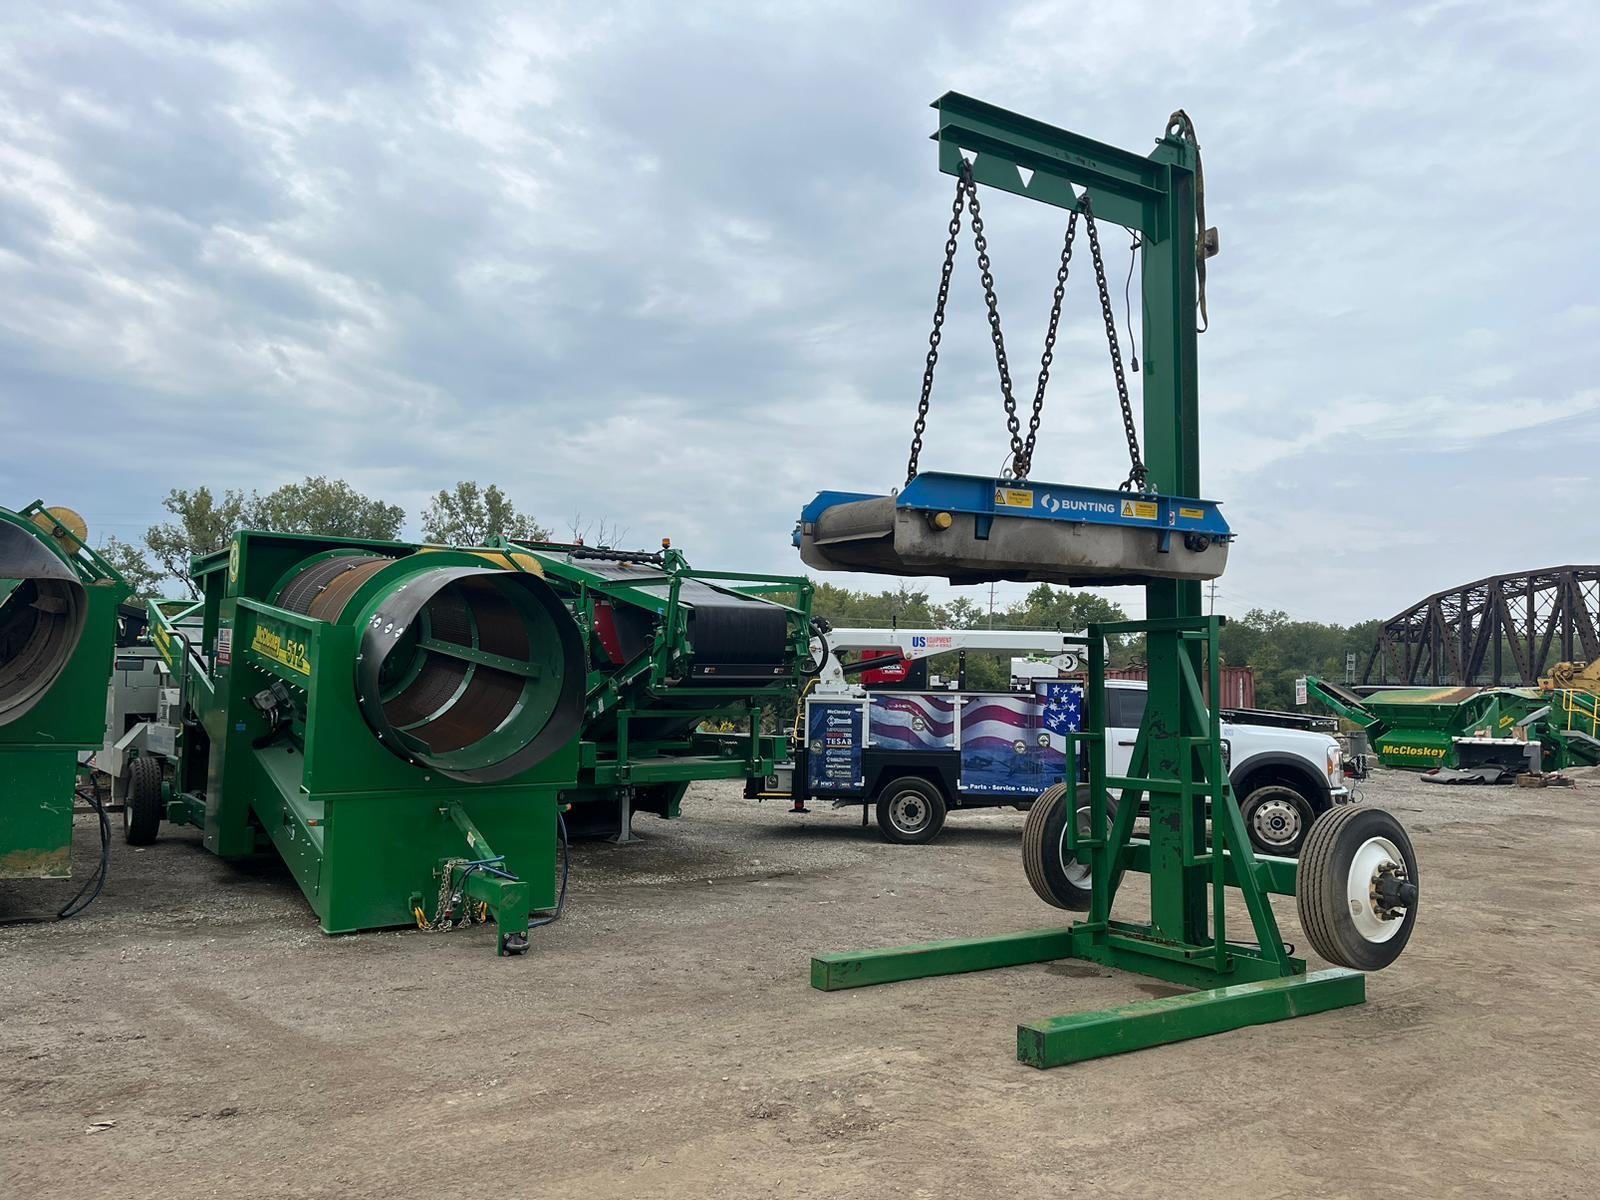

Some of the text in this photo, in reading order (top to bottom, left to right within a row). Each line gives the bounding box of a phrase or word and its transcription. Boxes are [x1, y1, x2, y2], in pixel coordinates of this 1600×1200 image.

[1061, 499, 1115, 513] BUNTING
[912, 636, 926, 648] US
[286, 640, 305, 668] 512
[1383, 745, 1447, 758] McCloskey
